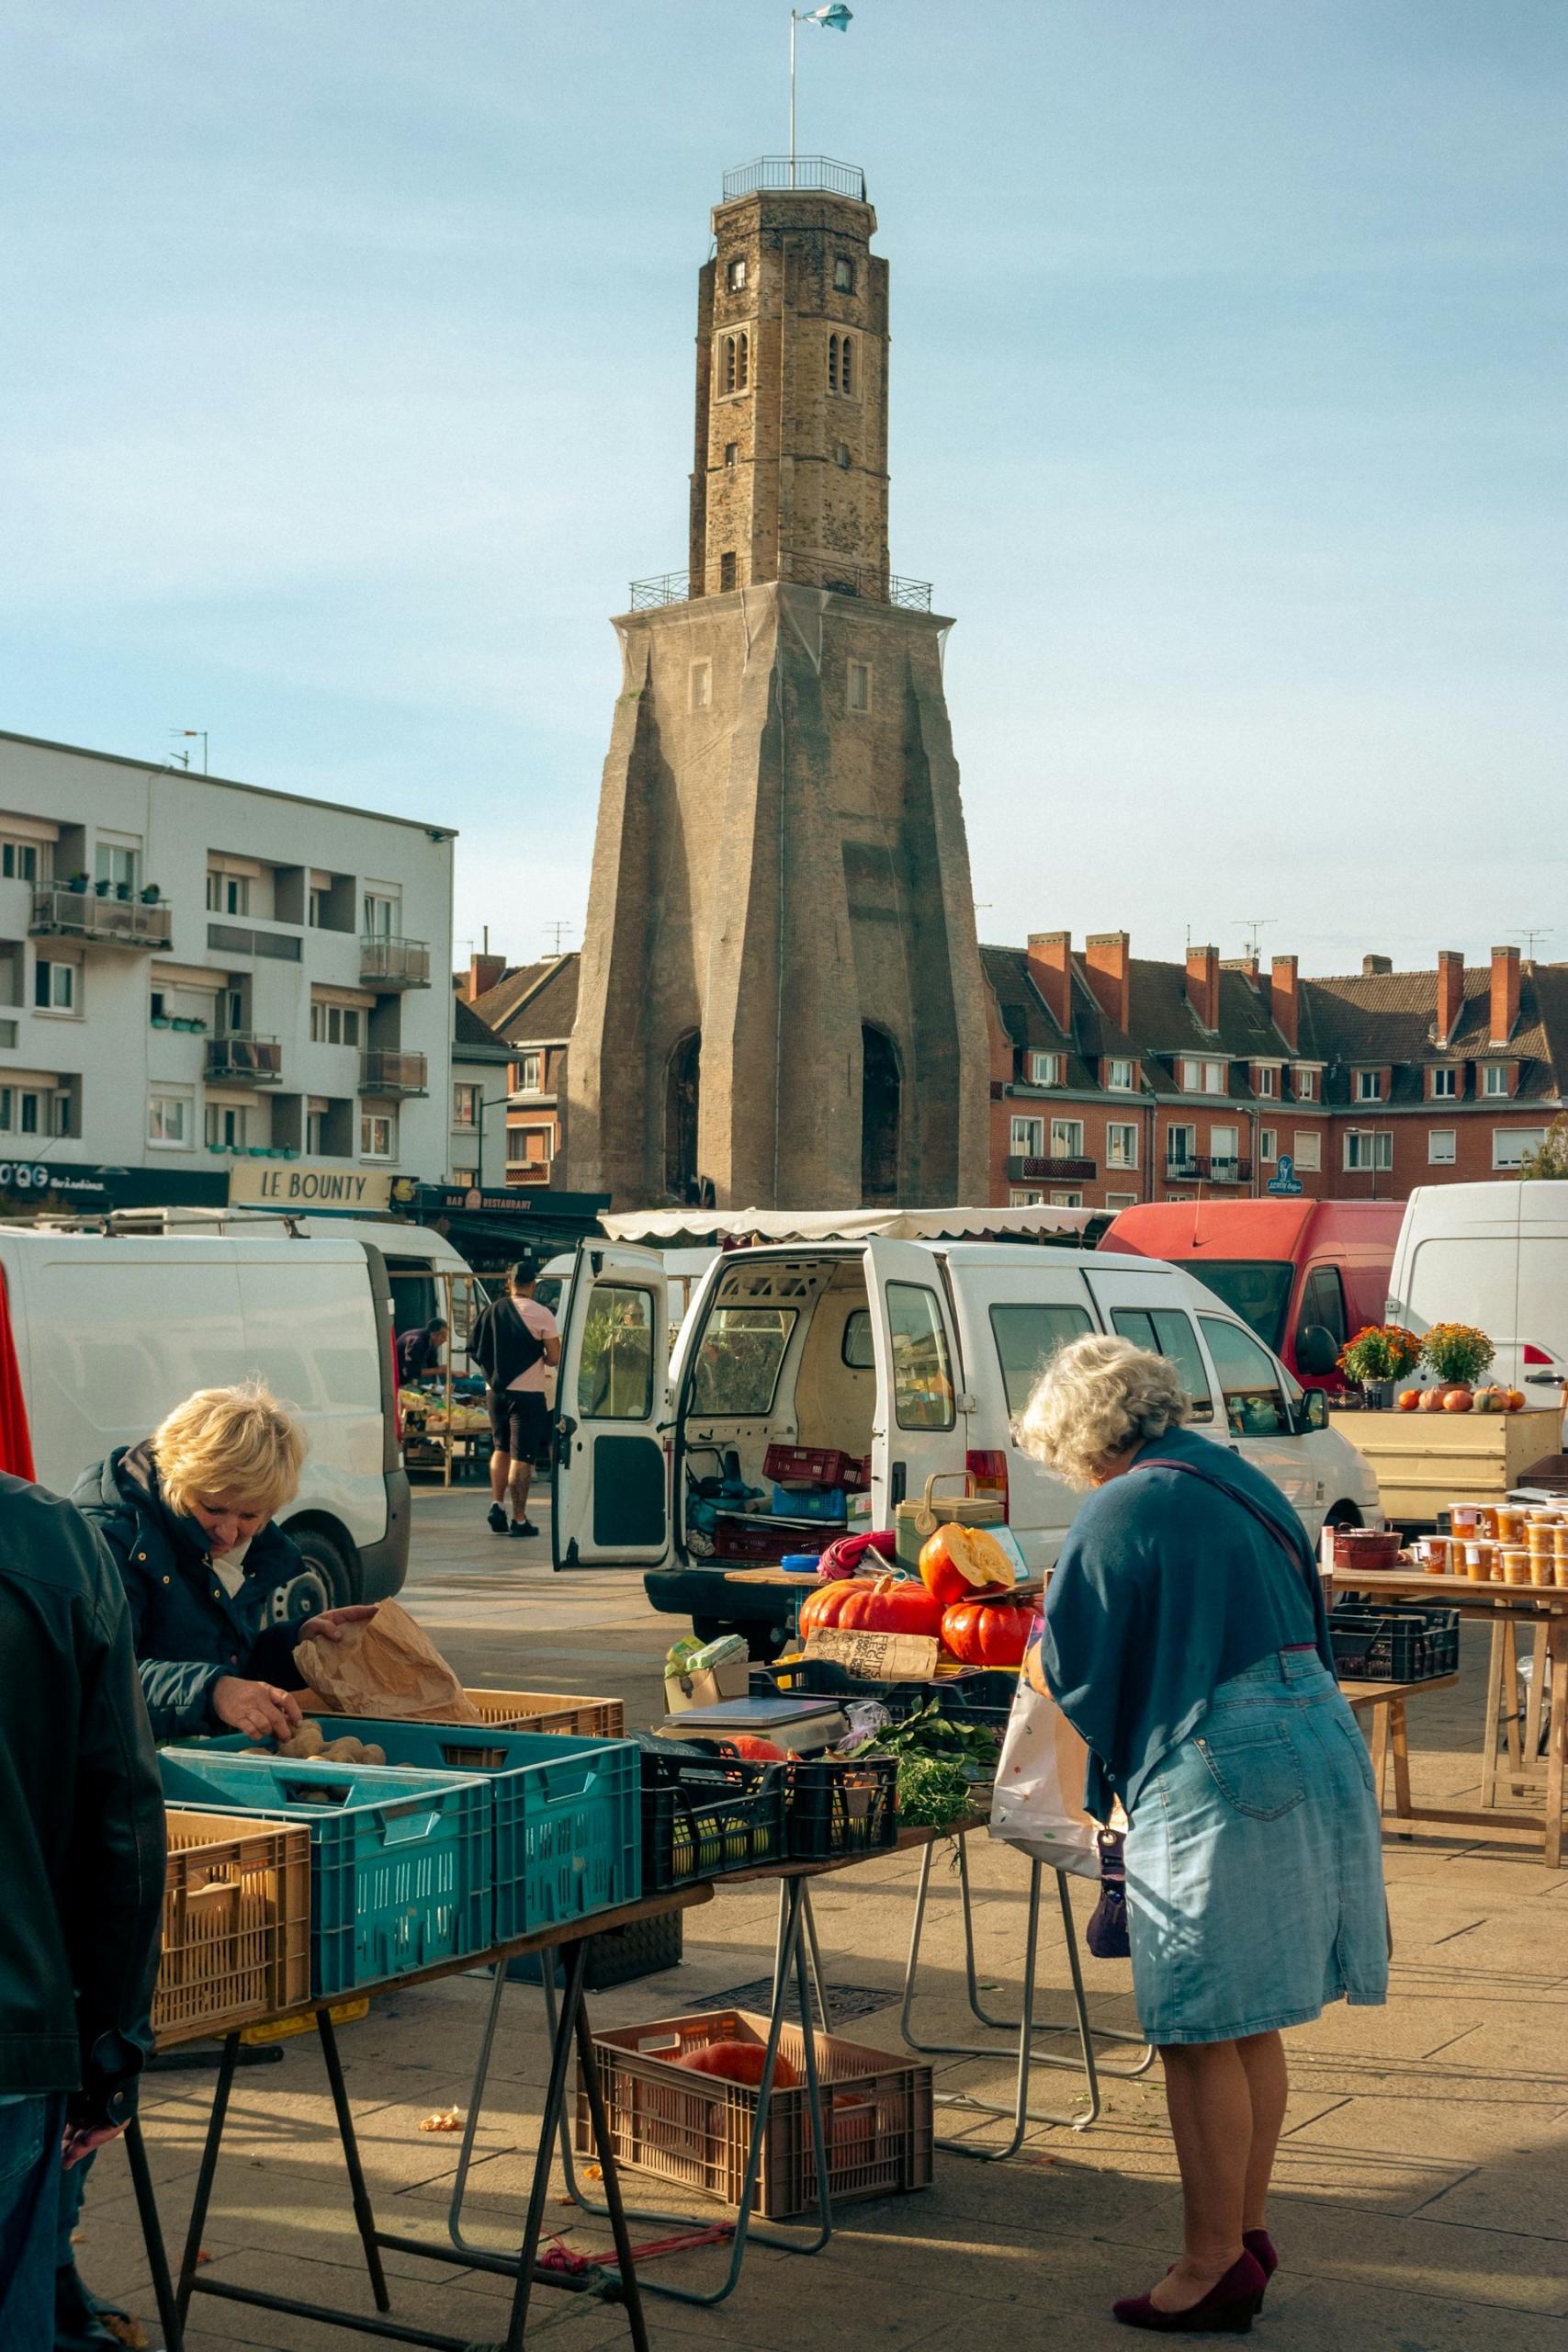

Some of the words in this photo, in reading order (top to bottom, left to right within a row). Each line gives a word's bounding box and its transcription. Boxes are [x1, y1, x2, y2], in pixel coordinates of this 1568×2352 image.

[262, 1170, 283, 1197] LE
[288, 1172, 367, 1201] BOUNTY
[446, 1196, 463, 1206] BAR
[483, 1198, 532, 1210] RESTAURANT
[871, 1634, 889, 1679] FRUITS
